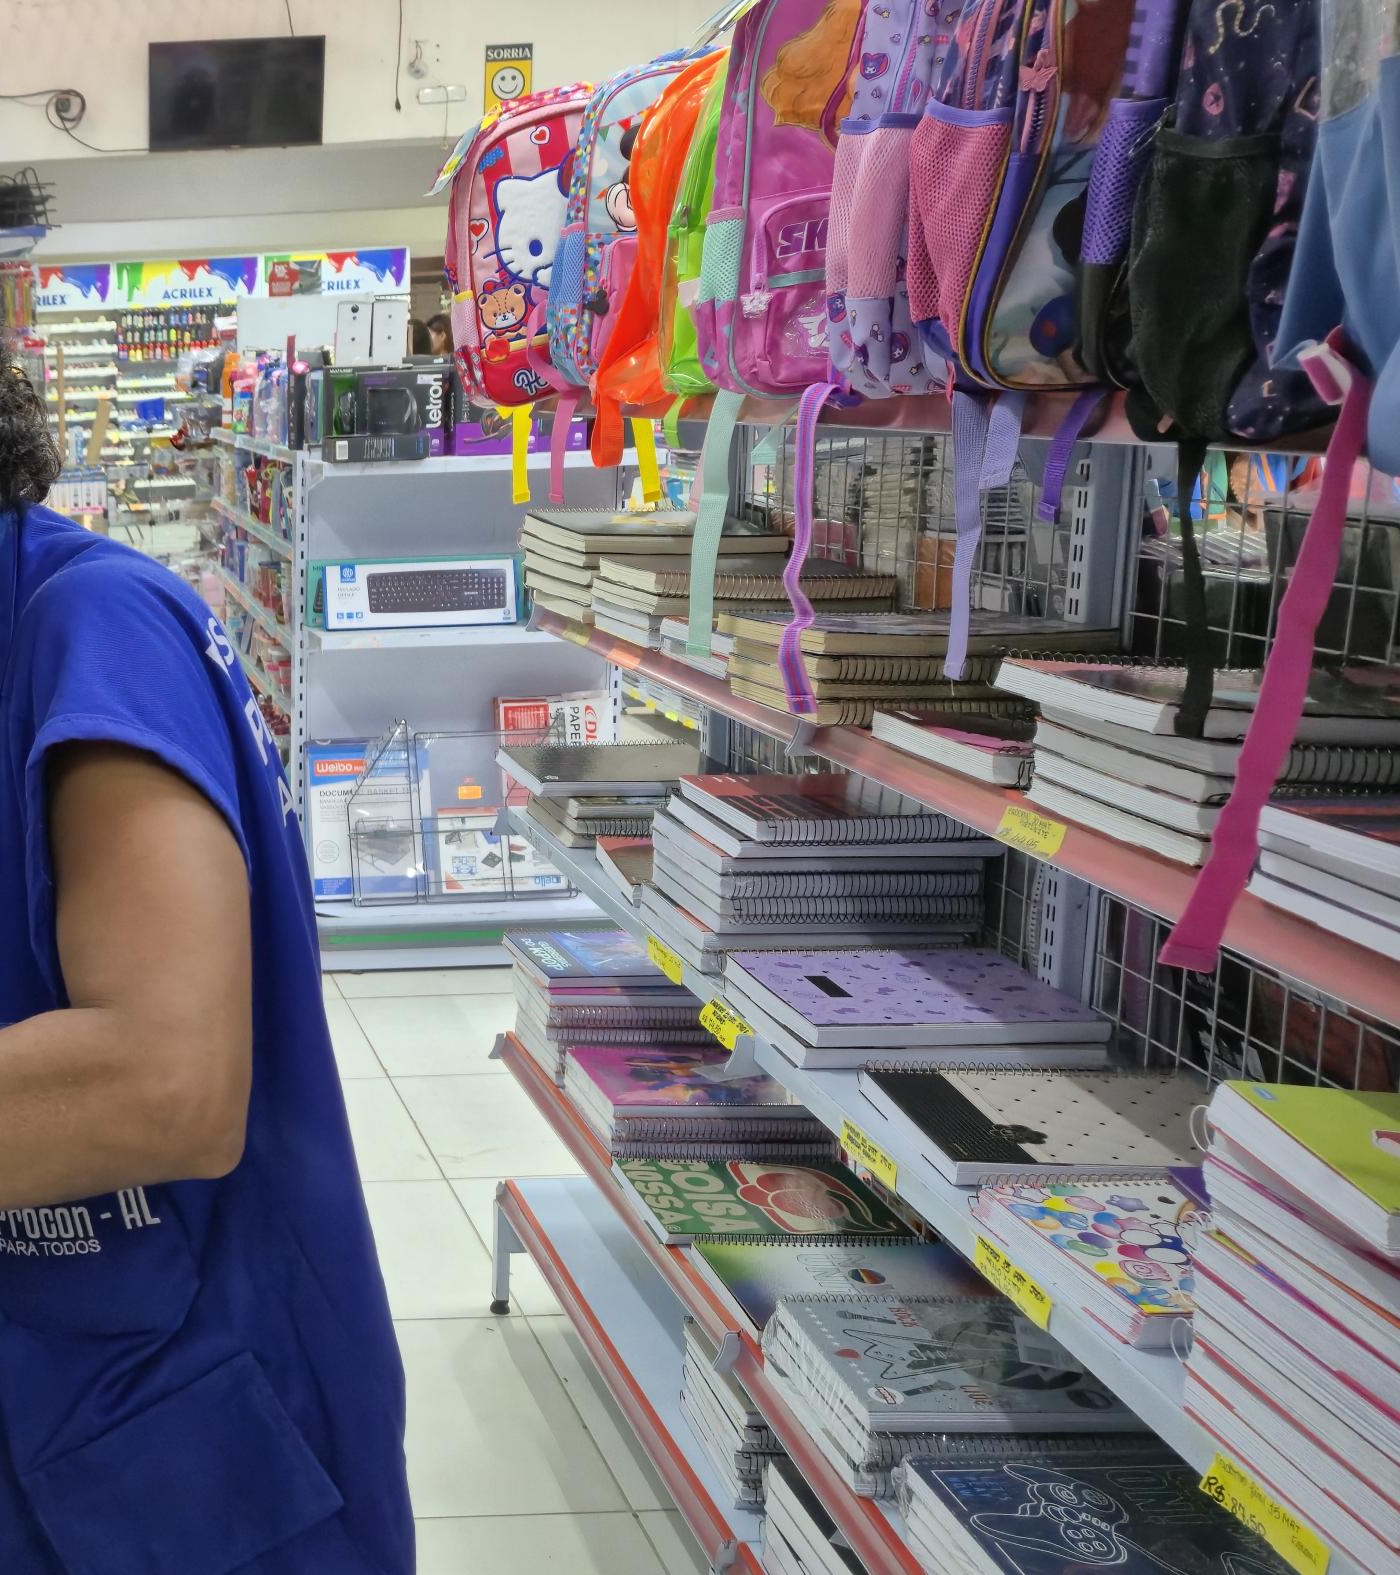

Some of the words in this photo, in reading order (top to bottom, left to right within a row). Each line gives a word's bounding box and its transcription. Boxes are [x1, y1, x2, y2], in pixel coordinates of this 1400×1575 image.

[487, 47, 531, 60] SORRIA
[162, 287, 214, 300] ACRILEX
[425, 373, 443, 429] Letron
[316, 762, 353, 773] Weibo
[117, 1186, 161, 1230] AL
[39, 1239, 101, 1256] TODOS
